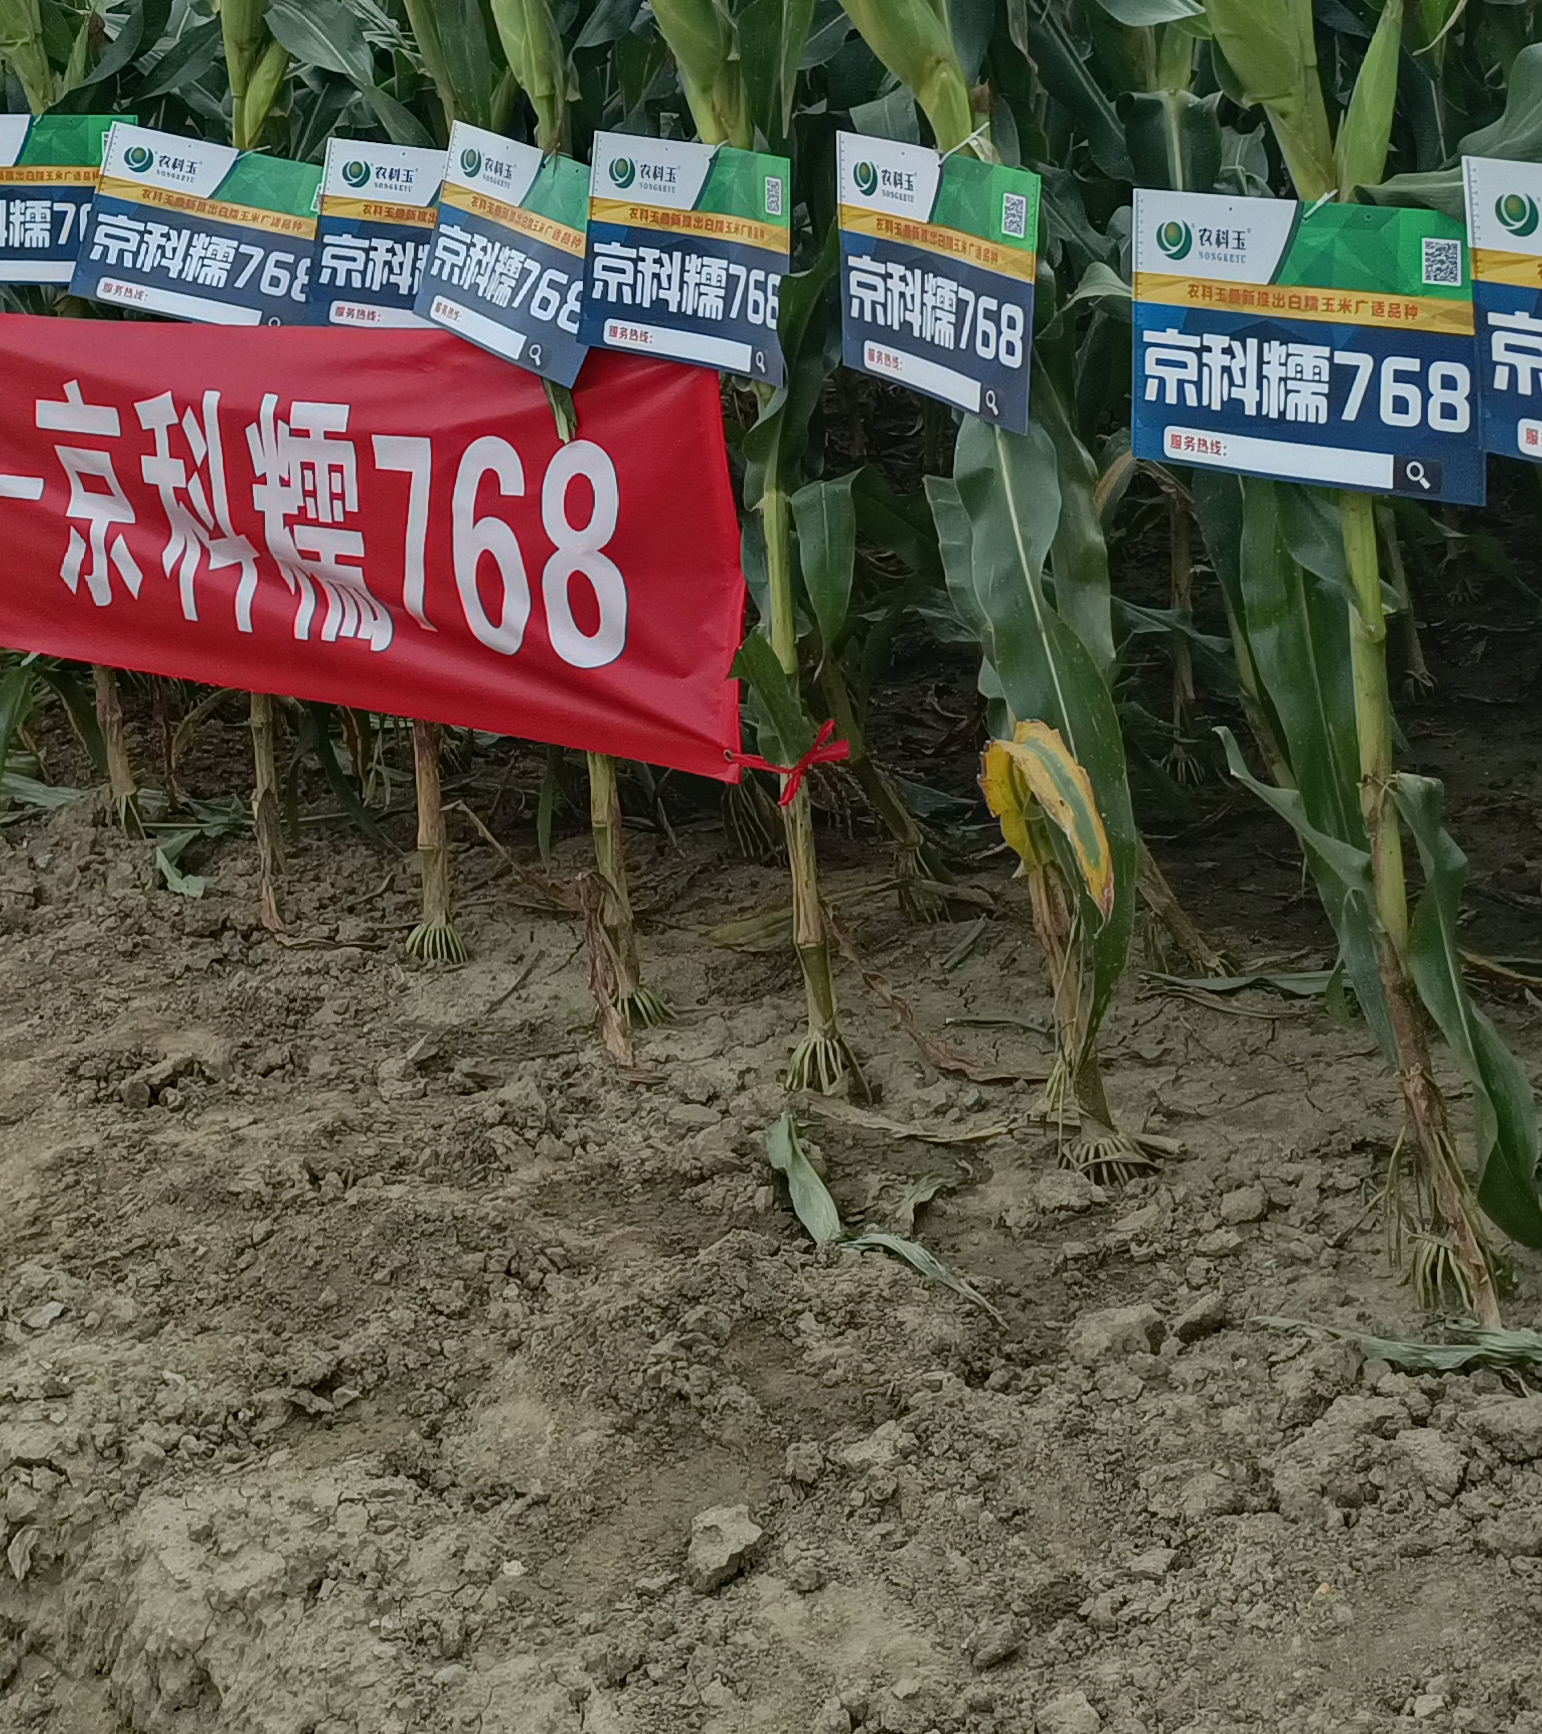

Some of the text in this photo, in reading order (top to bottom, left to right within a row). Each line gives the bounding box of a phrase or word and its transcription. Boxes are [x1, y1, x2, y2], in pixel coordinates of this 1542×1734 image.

[159, 154, 198, 176] 农科玉
[375, 165, 414, 184] 农科玉
[639, 162, 678, 184] 农科玉
[89, 213, 312, 303] 京科糯768
[1198, 227, 1248, 251] 农科玉
[429, 223, 584, 335] 京科糯768
[591, 241, 782, 332] 京科糯768
[847, 254, 1025, 369] 京科糯768
[1142, 328, 1471, 434] 京科糯768
[1169, 433, 1229, 458] 服务热线:
